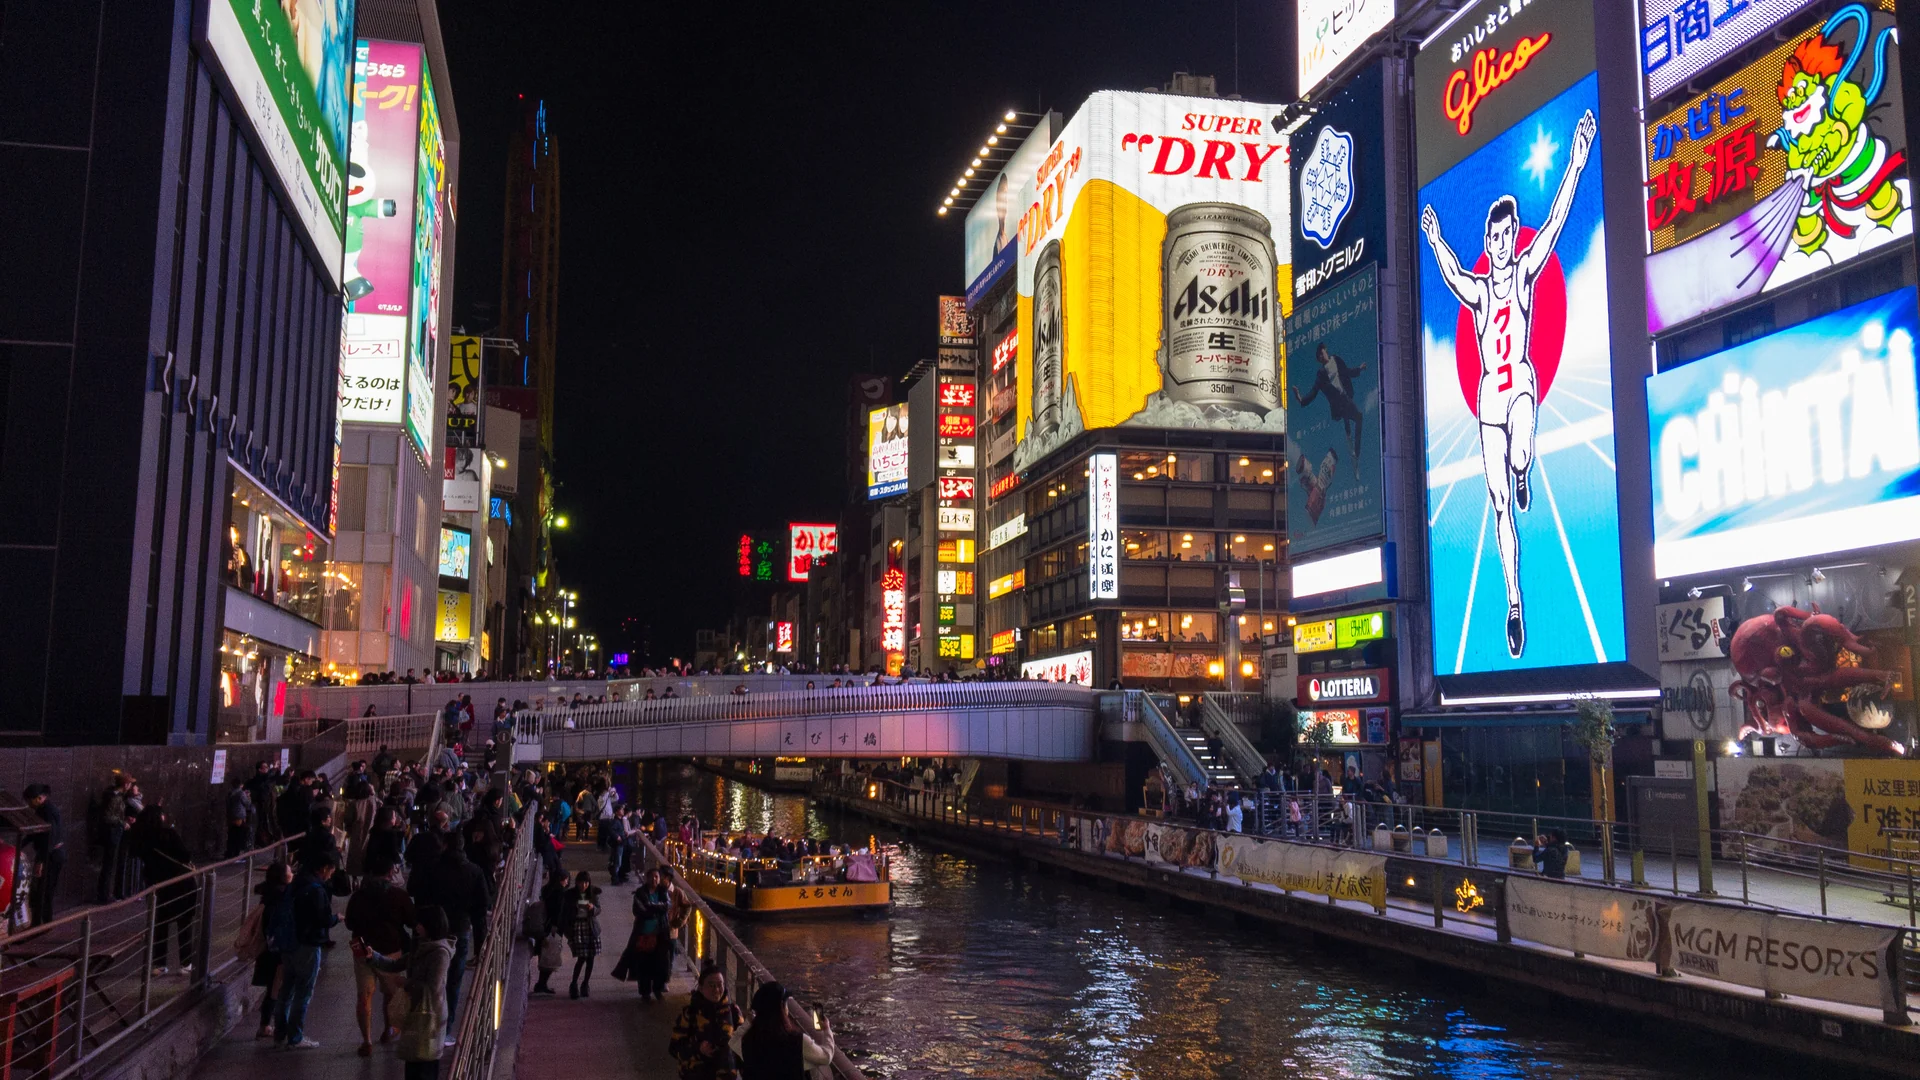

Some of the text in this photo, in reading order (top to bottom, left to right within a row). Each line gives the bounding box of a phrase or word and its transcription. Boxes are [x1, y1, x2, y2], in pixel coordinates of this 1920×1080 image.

[1445, 33, 1550, 134] Glico
[1182, 112, 1262, 135] SUPER
[1651, 88, 1746, 161] かぜに
[1036, 141, 1065, 190] SUPER
[1644, 120, 1758, 231] 改源
[1184, 241, 1258, 271] ASAHI BREWERIES LIMITED
[1295, 238, 1365, 298] 雪印メグミルク
[1173, 275, 1268, 324] Asahi
[1207, 331, 1236, 351] 生
[1493, 301, 1513, 392] グリコ
[1195, 354, 1250, 366] スーパードライ
[1209, 365, 1233, 373] 生ビール
[1210, 384, 1235, 394] 350ml
[1101, 477, 1112, 522] 本場の味
[941, 511, 970, 524] 白木屋
[794, 530, 836, 551] かに
[1668, 607, 1711, 650] くくる
[1321, 676, 1373, 697] LOTTERIA
[784, 731, 877, 746] えびす橋
[799, 886, 853, 899] えちぜん
[1316, 870, 1372, 897] しまだ病院
[1674, 922, 1879, 979] MGM RESORTS
[1680, 952, 1717, 973] JAPAN
